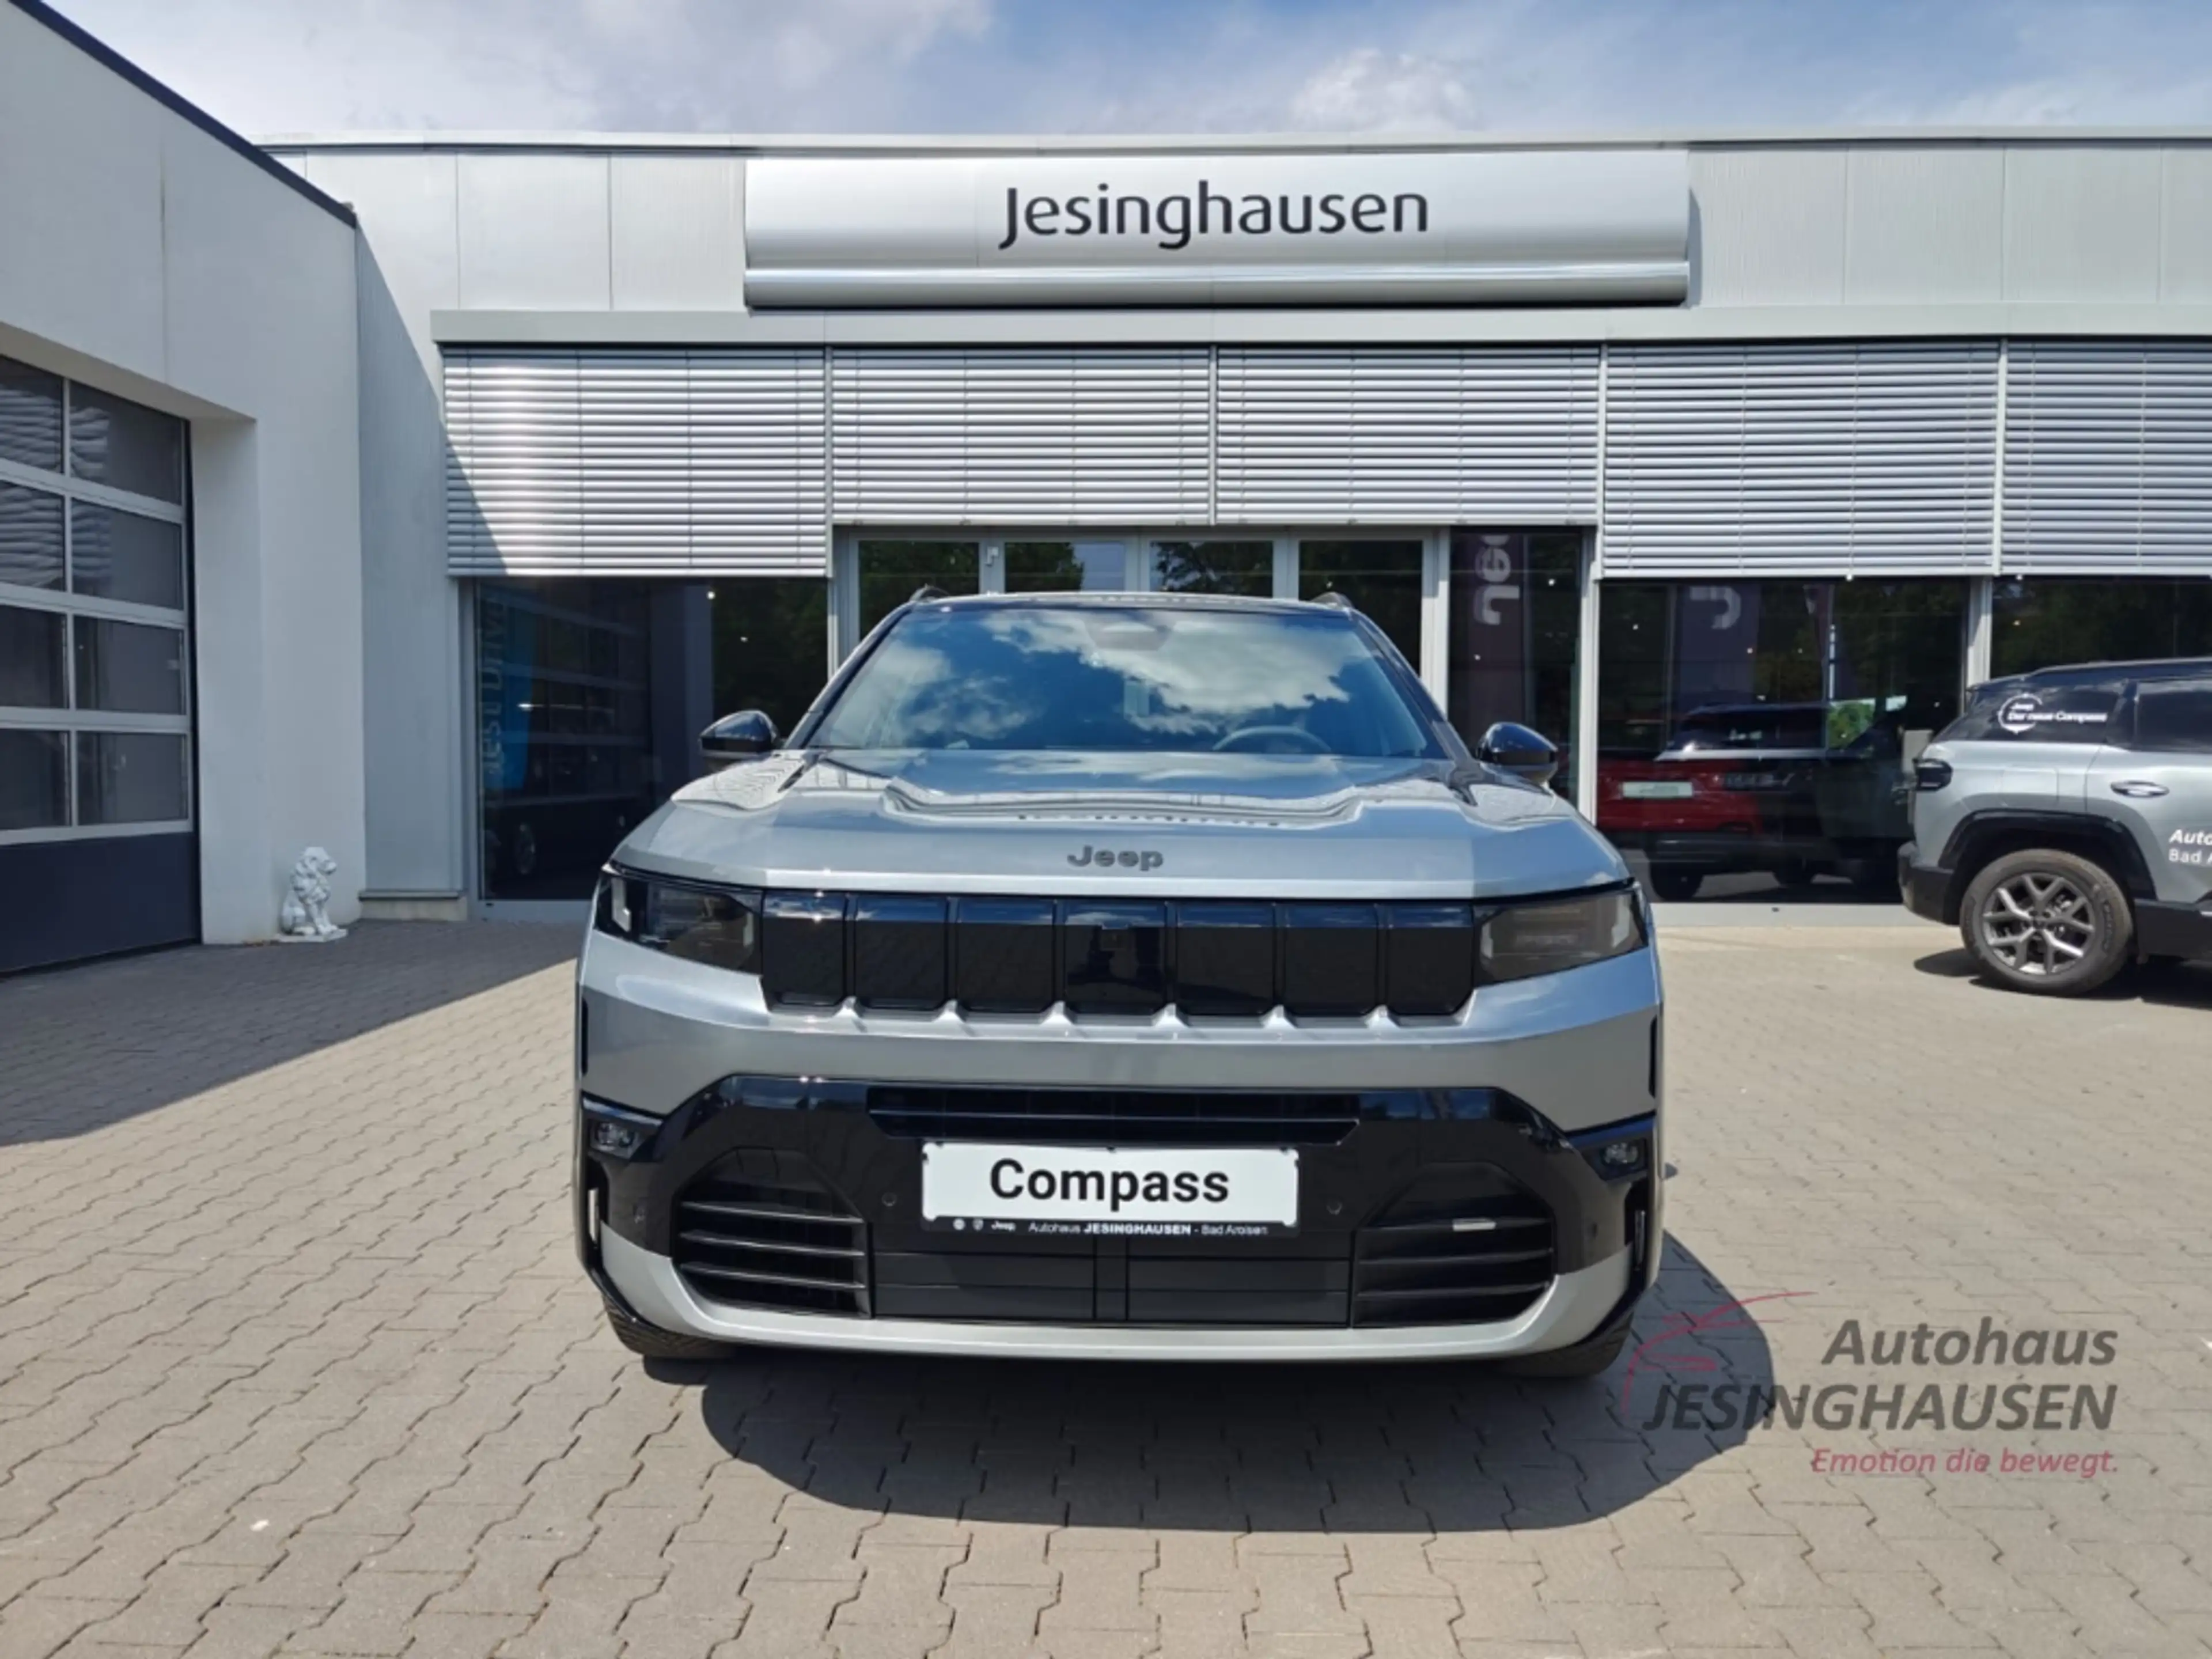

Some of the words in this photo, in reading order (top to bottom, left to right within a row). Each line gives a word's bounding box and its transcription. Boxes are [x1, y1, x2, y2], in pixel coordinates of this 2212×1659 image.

[998, 180, 1427, 250] Jesinghausen
[1067, 845, 1164, 872] Jeep
[2169, 848, 2202, 864] Bad
[990, 1158, 1229, 1212] Compass
[1028, 1221, 1081, 1234] Autohaus
[1084, 1222, 1191, 1236] JESINGHAUSEN
[1201, 1224, 1224, 1235] Bad
